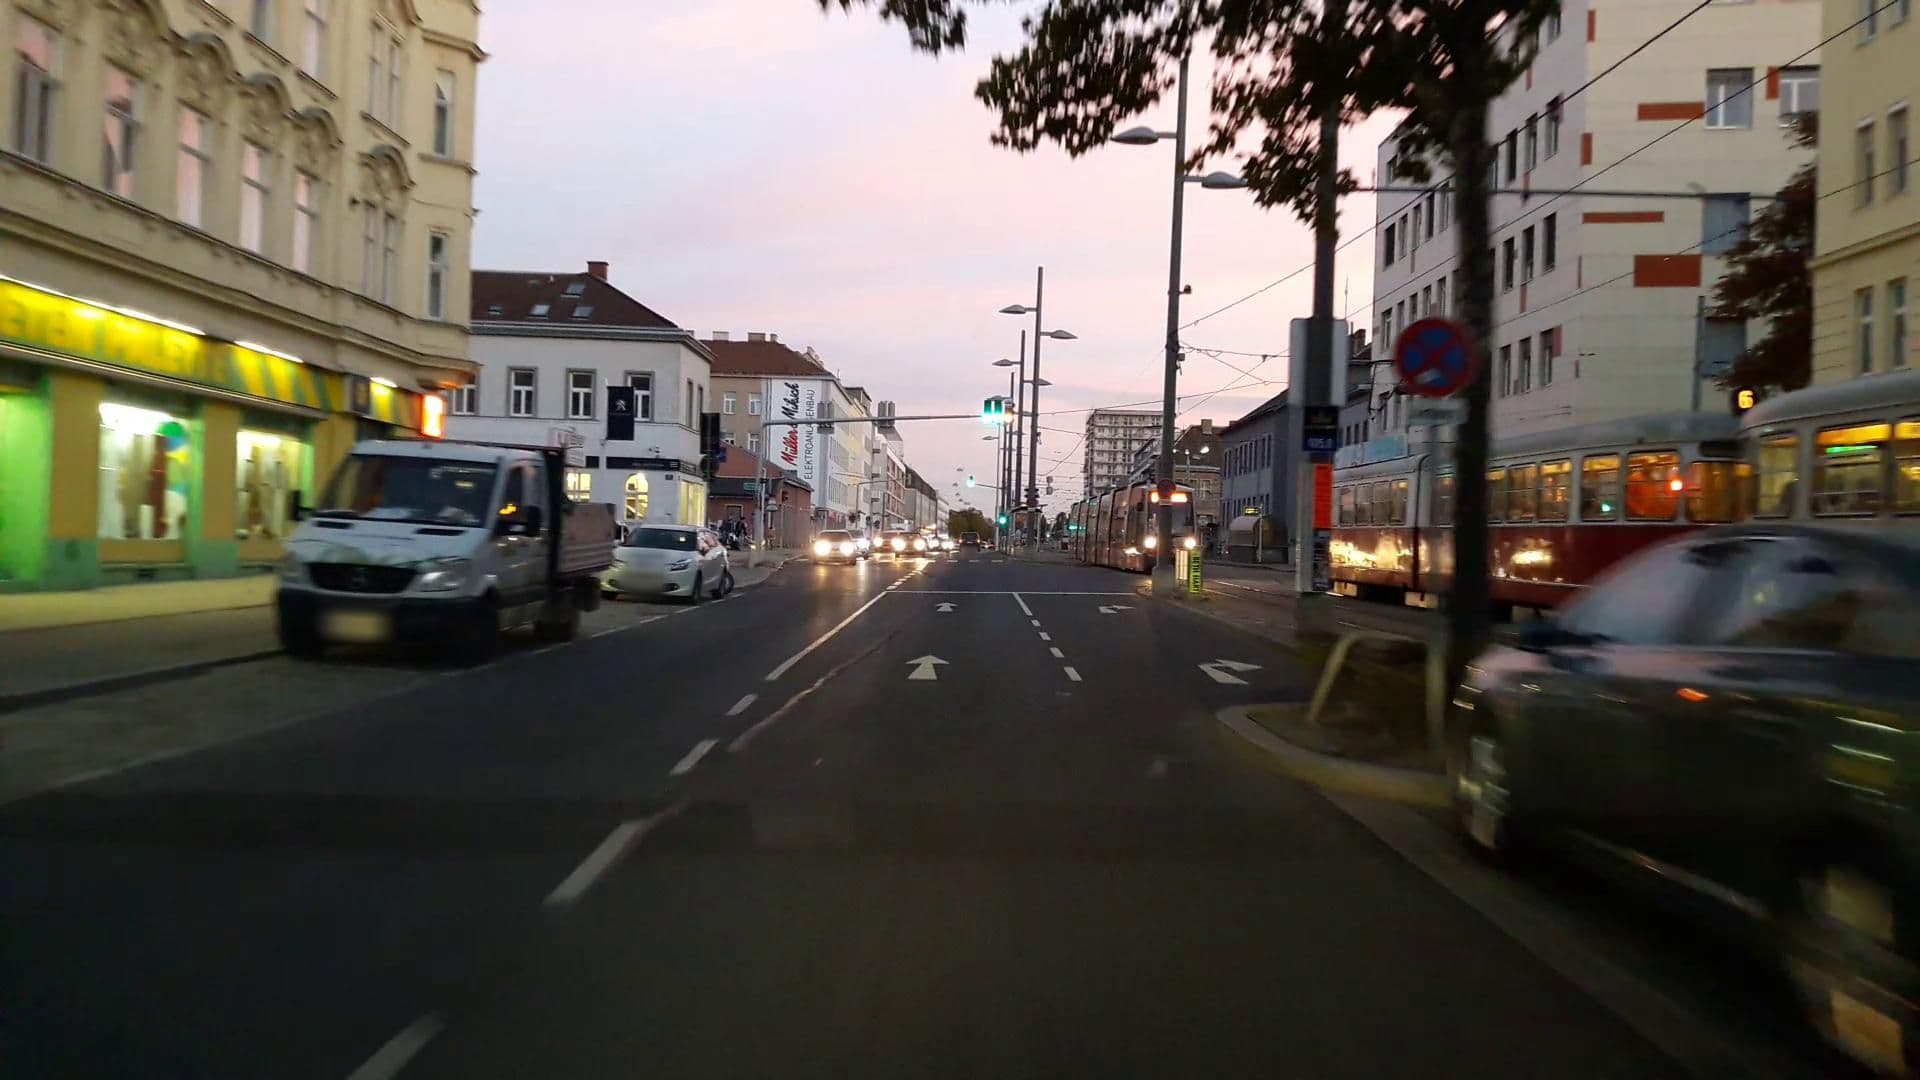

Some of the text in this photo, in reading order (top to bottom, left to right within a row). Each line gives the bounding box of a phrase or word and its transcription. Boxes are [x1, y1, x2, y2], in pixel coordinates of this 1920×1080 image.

[1738, 390, 1753, 408] 6
[781, 430, 799, 466] Müller
[804, 389, 816, 480] ELEKTROANLAENBAU
